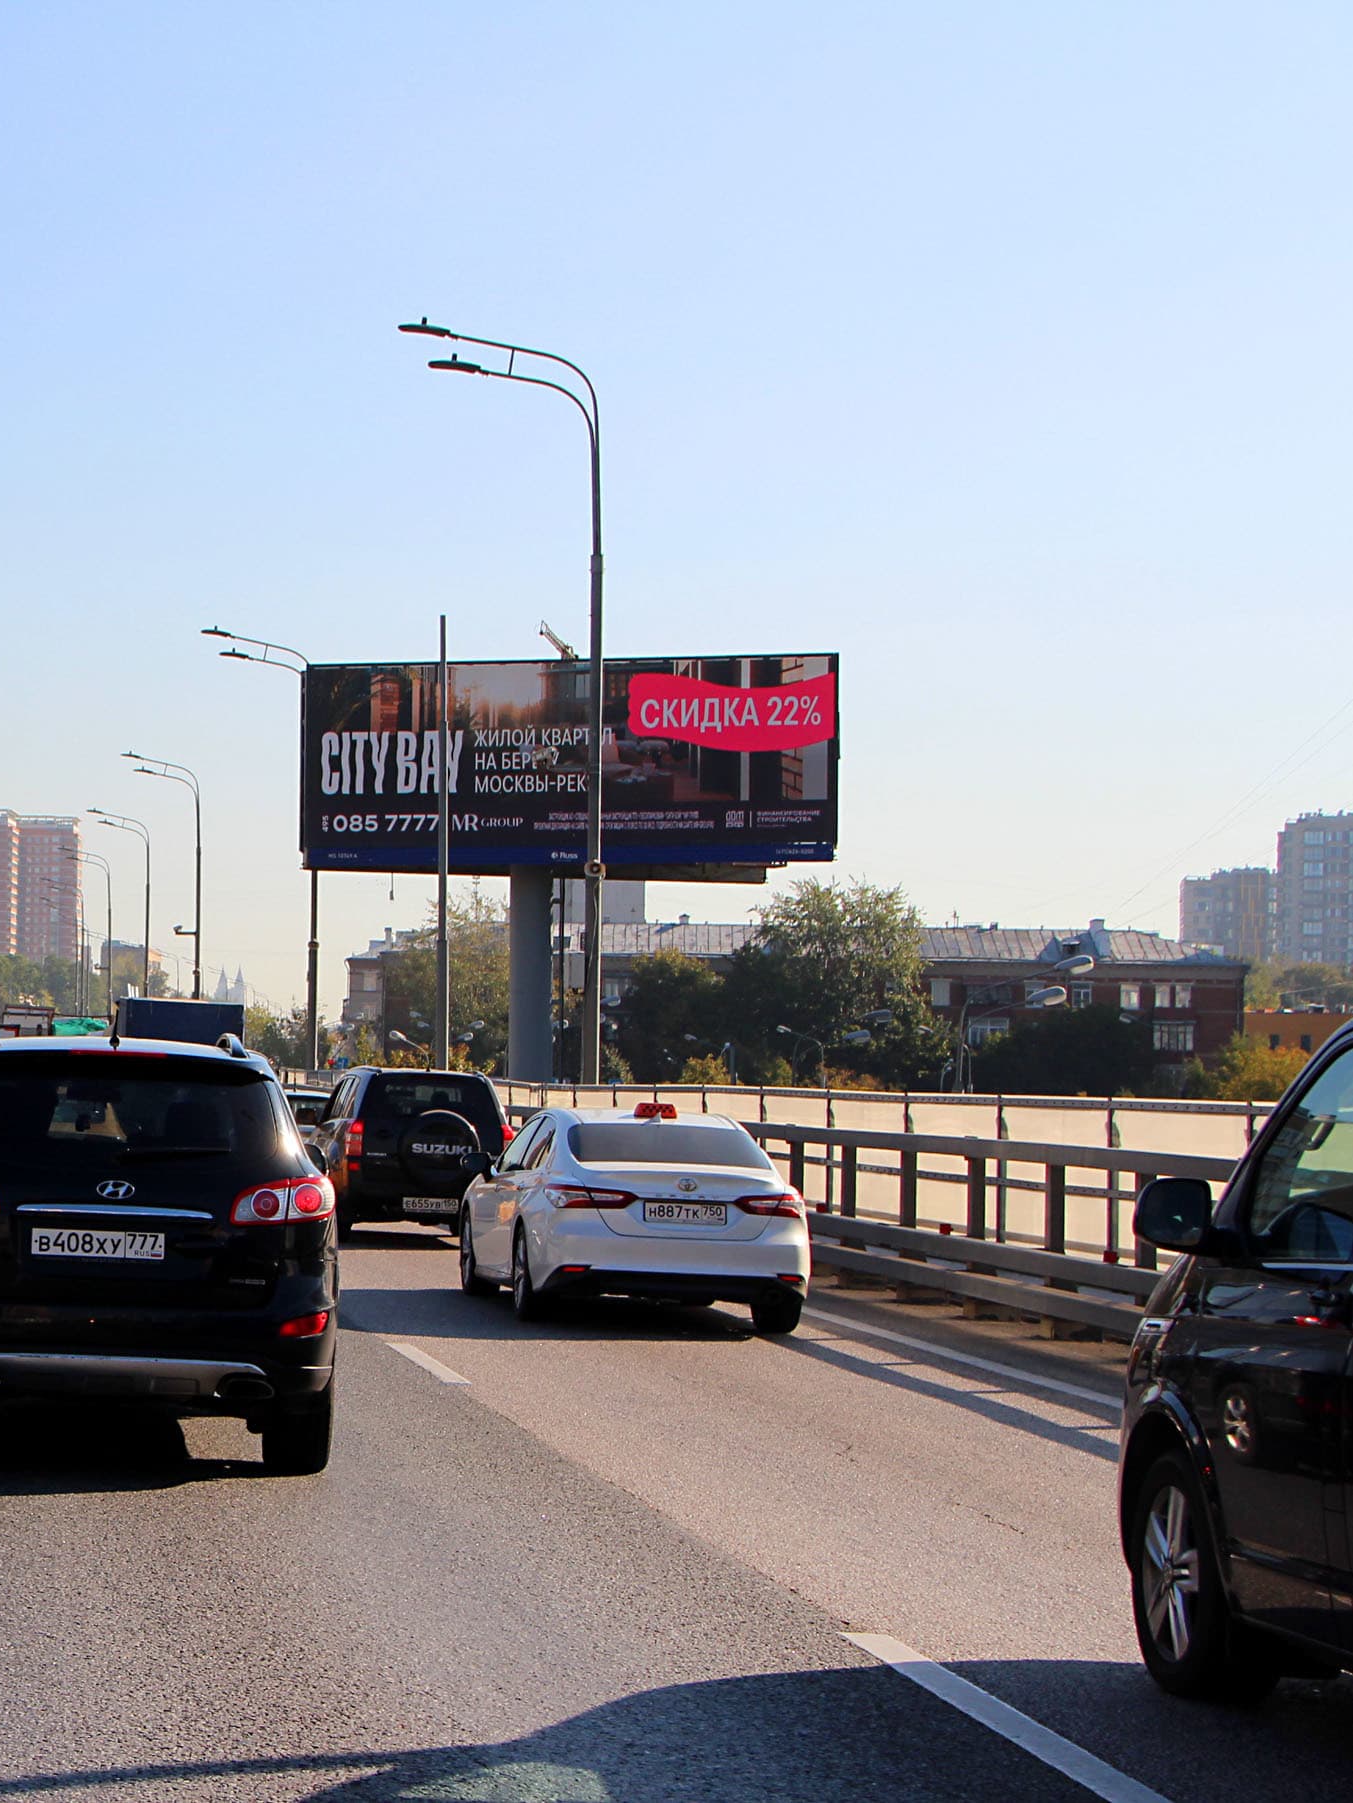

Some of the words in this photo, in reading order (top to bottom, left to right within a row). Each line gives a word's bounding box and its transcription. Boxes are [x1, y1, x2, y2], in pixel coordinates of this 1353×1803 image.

[640, 697, 760, 733] СКИДКА
[767, 695, 822, 726] 22%
[474, 724, 536, 747] ЖИЛОЙ
[541, 726, 613, 746] КВАРТЛ
[321, 731, 390, 795] CITY
[396, 729, 464, 795] BAY
[474, 752, 497, 770] НА
[501, 750, 560, 770] БЕРУ
[474, 774, 590, 793] МОСКВЫ-РЕК
[332, 814, 379, 832] 085
[384, 814, 439, 832] 7777
[452, 814, 479, 832] MR
[480, 817, 523, 828] GROUP
[411, 1142, 473, 1156] SUZUKI
[702, 1205, 723, 1217] 750
[126, 1233, 158, 1250] 777
